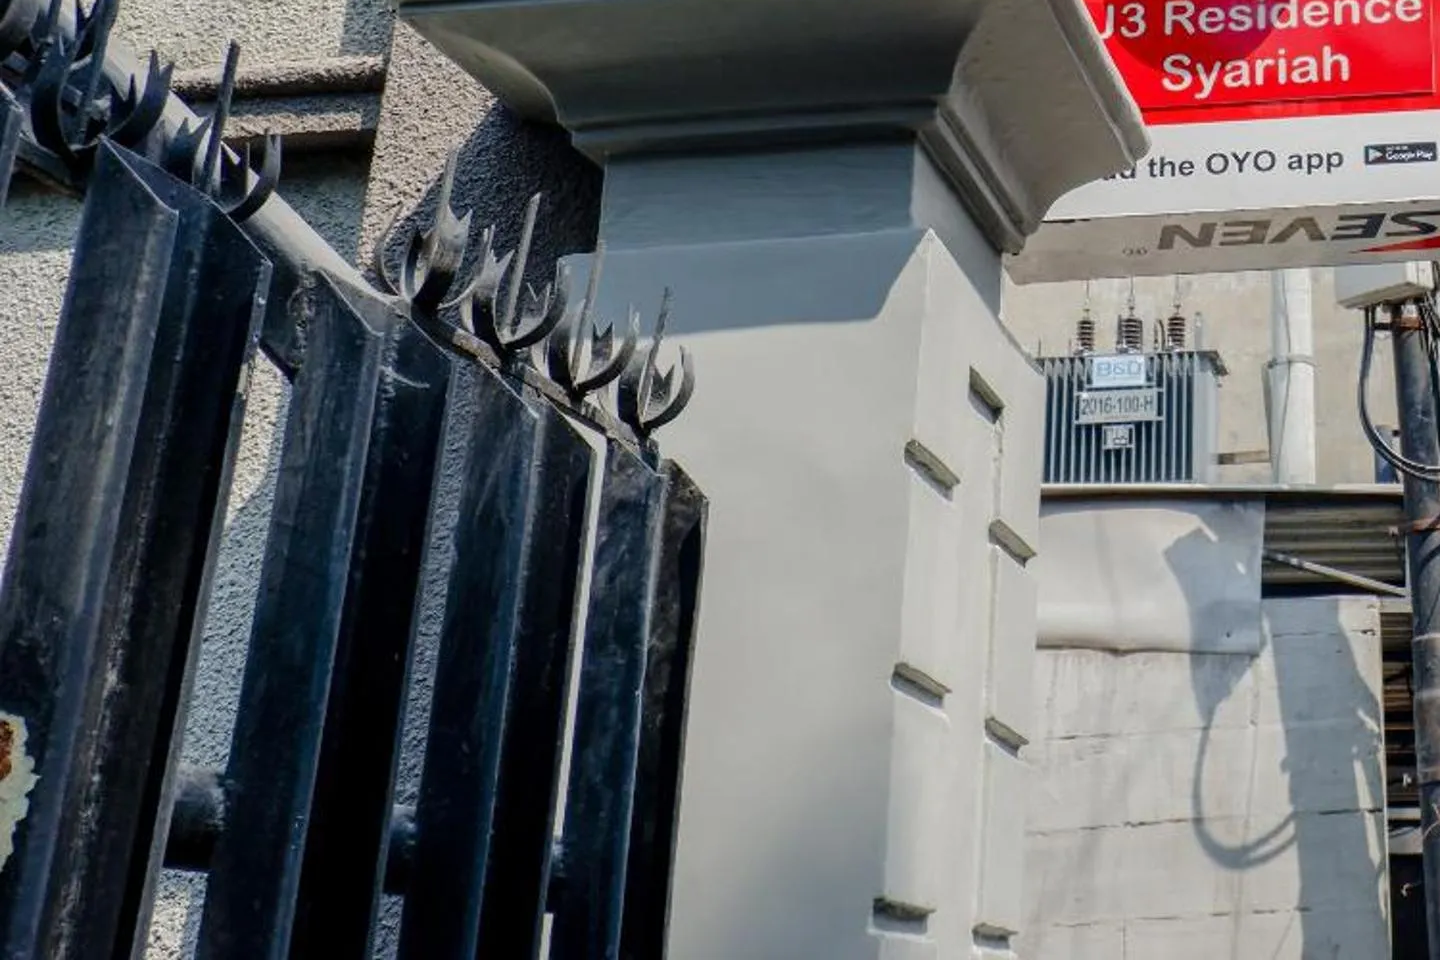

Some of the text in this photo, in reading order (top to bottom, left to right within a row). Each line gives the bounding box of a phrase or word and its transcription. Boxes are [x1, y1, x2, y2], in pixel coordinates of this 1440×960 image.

[1162, 46, 1350, 99] Syariah
[1148, 156, 1195, 178] the
[1205, 149, 1277, 175] OYO
[1287, 150, 1344, 175] app
